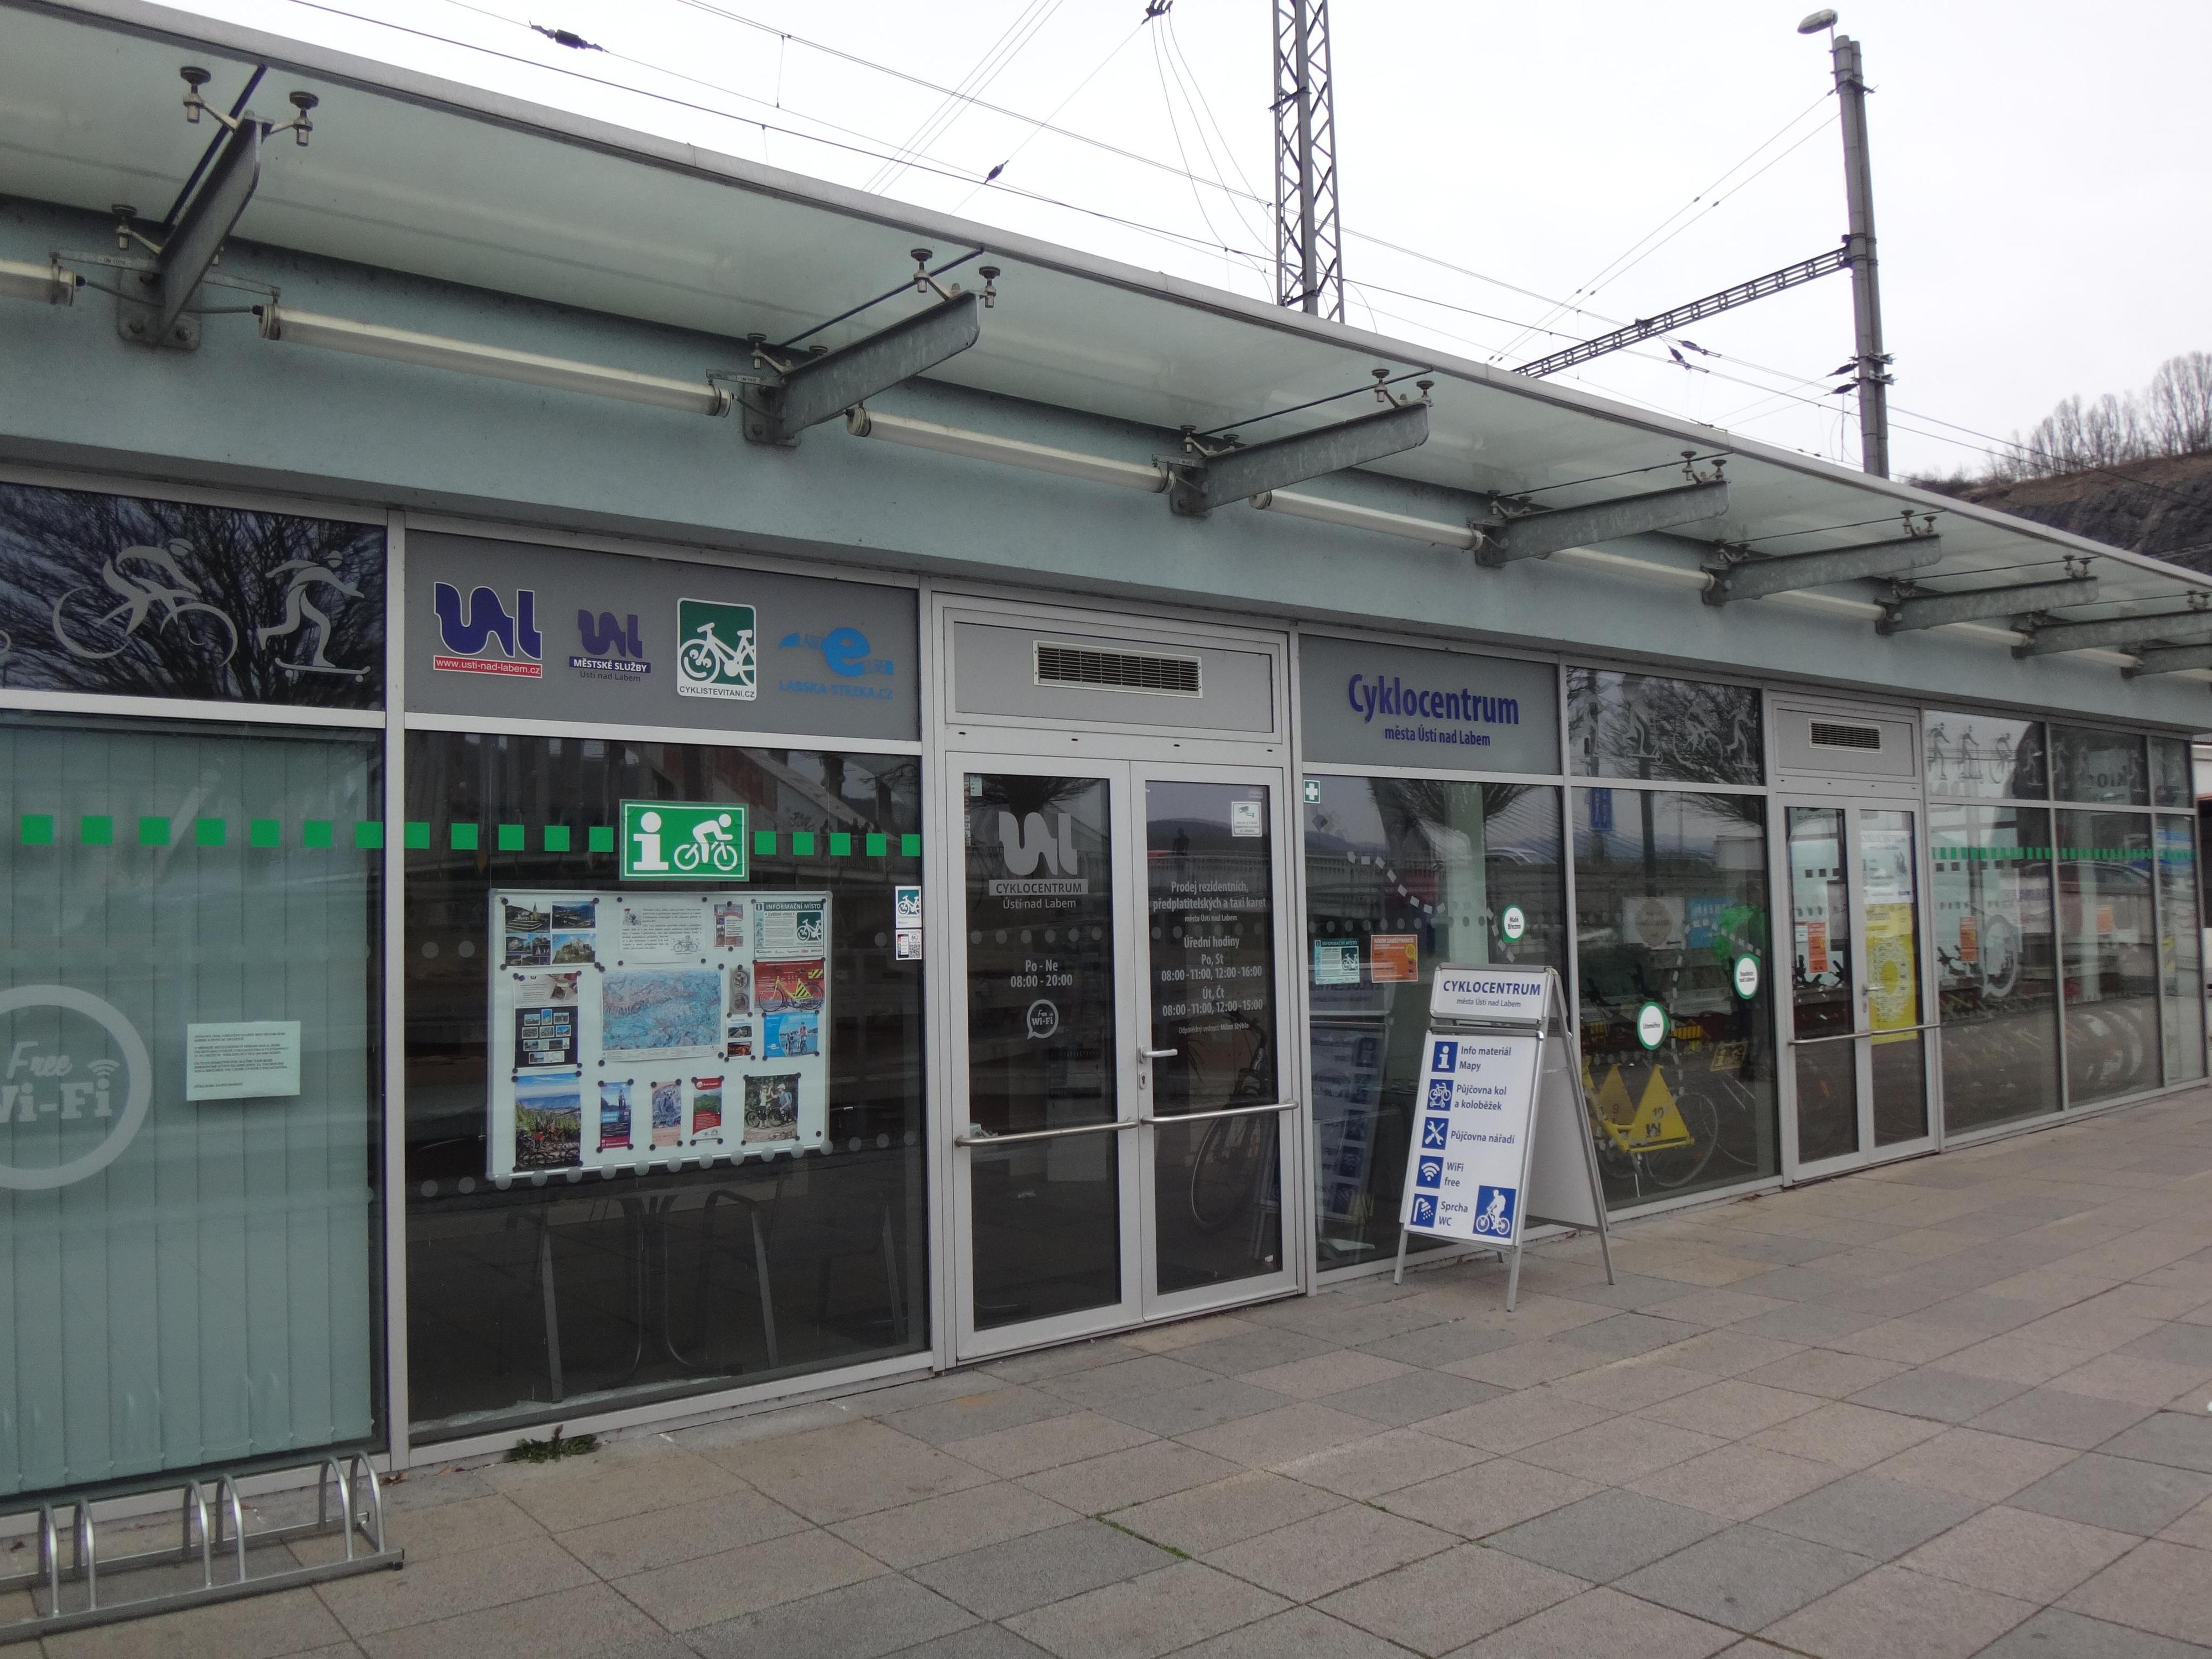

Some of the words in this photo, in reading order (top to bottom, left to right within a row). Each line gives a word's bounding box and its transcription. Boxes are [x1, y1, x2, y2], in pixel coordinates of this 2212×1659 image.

[436, 659, 540, 675] www.usti-nad-labem.cz
[573, 657, 613, 670] MĚSTSKÉ
[614, 660, 647, 673] SLUŽBY
[580, 670, 594, 680] Ústí
[597, 671, 613, 681] nad
[615, 672, 641, 682] Labem
[680, 685, 755, 698] CYKLISTEVITANI.CZ
[1348, 673, 1520, 724] Cyklocentrum
[1385, 725, 1416, 742] města
[1418, 724, 1437, 743] Ústí
[1439, 730, 1457, 744] nad
[1459, 731, 1491, 746] Labem
[996, 883, 1082, 894] CYKLOCENTRUM
[1171, 881, 1197, 895] Prodej
[1198, 880, 1249, 894] rezidentních,
[1003, 897, 1022, 909] Ústí
[1024, 899, 1042, 908] nad
[1045, 898, 1076, 908] Labem
[1153, 897, 1222, 912] předplatitelských
[1229, 898, 1245, 908] taxi
[1246, 897, 1267, 907] karet
[1221, 913, 1238, 921] Labem
[1184, 935, 1210, 949] Úřední
[1212, 935, 1240, 949] hodiny
[1025, 959, 1037, 972] Po
[1046, 959, 1058, 972] Ne
[1201, 954, 1213, 966] Po,
[1215, 954, 1224, 964] St
[1010, 975, 1038, 988] 08:00
[1046, 974, 1073, 987] 20:00
[1202, 985, 1214, 1000] Út,
[1216, 985, 1225, 999] Čt
[1443, 980, 1541, 997] CYKLOCENTRUM
[1475, 998, 1486, 1006] Ústí
[1031, 1017, 1054, 1026] Wi-Fi
[1460, 1046, 1477, 1056] Info
[1479, 1045, 1511, 1056] materiál
[7, 1041, 73, 1079] Free
[1459, 1061, 1481, 1072] Mapy
[1456, 1084, 1493, 1096] Půjčovna
[1494, 1086, 1507, 1095] kol
[1461, 1100, 1503, 1110] koloběžek
[1613, 1103, 1619, 1113] 9
[1451, 1130, 1486, 1142] Půjčovna
[1488, 1132, 1515, 1144] nářadí
[1447, 1162, 1464, 1172] WiFi
[1444, 1177, 1460, 1187] free
[1441, 1201, 1468, 1213] Sprcha
[1438, 1217, 1452, 1226] WC
